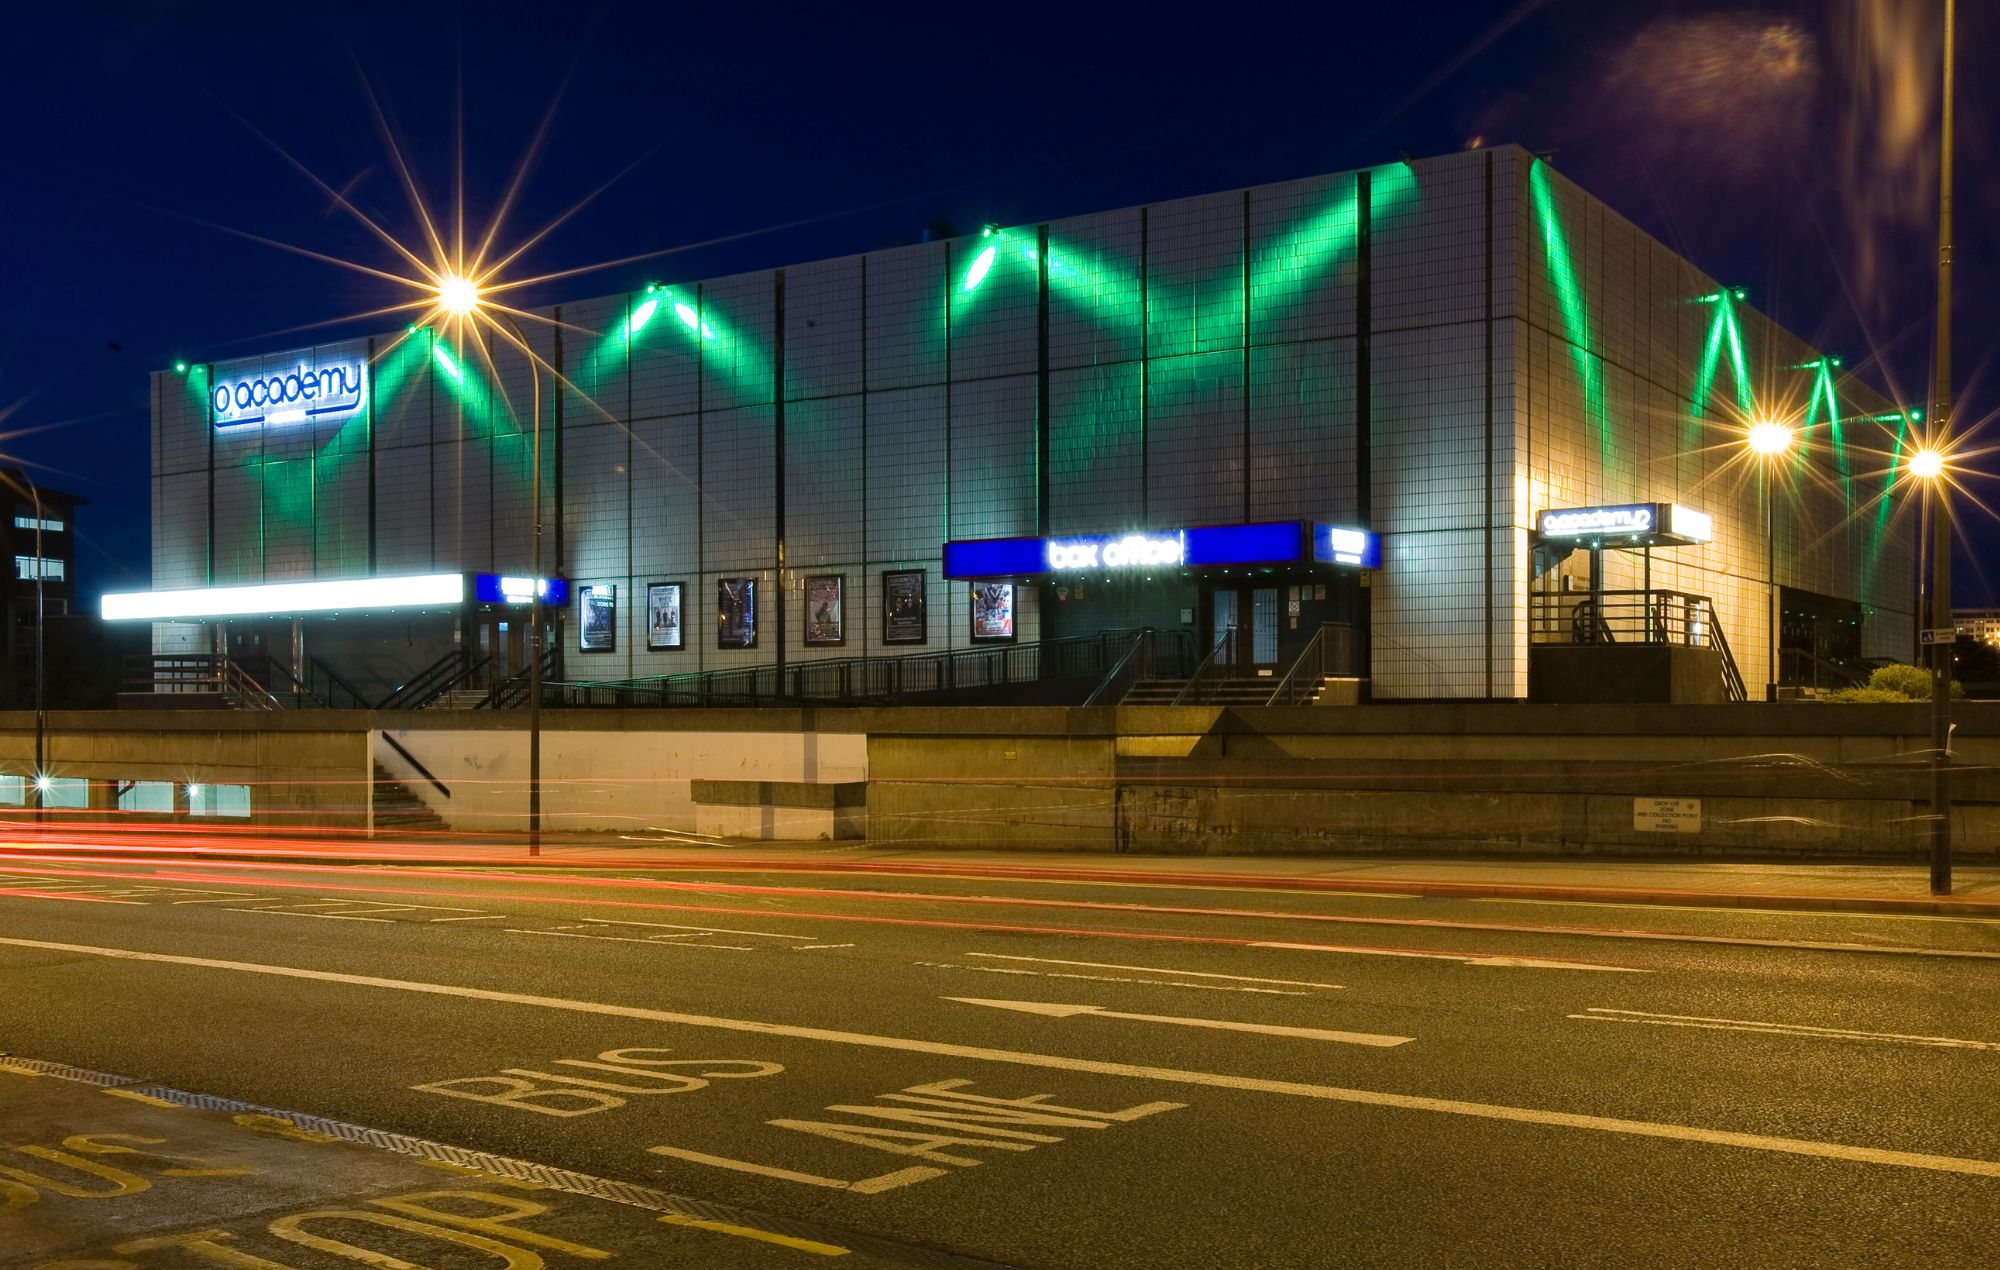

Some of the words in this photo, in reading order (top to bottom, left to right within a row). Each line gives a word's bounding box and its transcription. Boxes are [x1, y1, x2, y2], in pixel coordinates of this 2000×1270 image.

[235, 364, 361, 409] academy
[1049, 541, 1098, 569] box
[1103, 535, 1179, 567] office
[408, 1047, 785, 1118] BUS
[0, 1133, 262, 1211] US
[646, 1078, 1190, 1195] LANE
[33, 1191, 614, 1270] TOP
